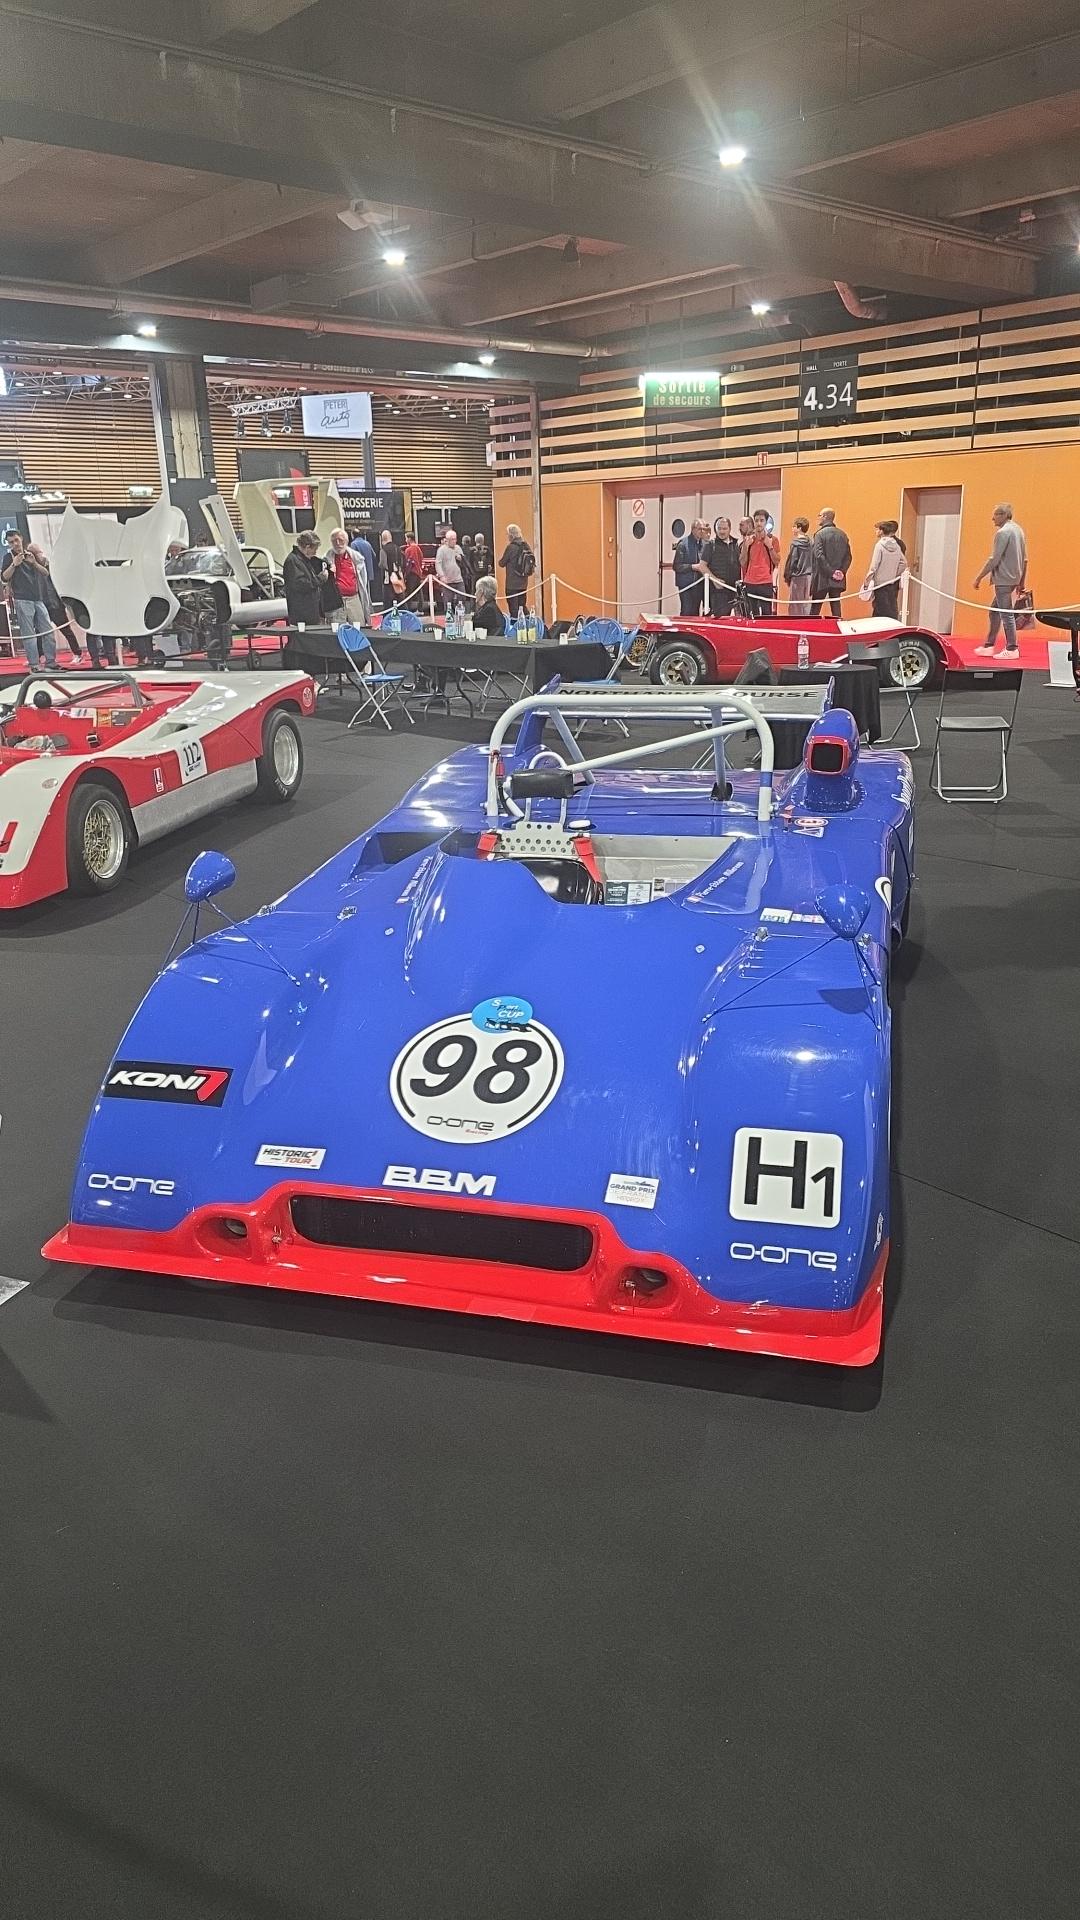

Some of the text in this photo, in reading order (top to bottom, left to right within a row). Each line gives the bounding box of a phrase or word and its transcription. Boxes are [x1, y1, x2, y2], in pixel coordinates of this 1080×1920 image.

[833, 360, 848, 368] PORTE
[658, 378, 706, 393] Sortie
[653, 394, 711, 406] de secours
[803, 381, 854, 411] 4.34
[325, 401, 346, 410] PETER
[716, 690, 819, 698] OURSE
[183, 742, 202, 766] 112
[498, 1010, 525, 1018] CUP
[409, 1034, 543, 1105] 98
[382, 1165, 497, 1197] BBM
[743, 1136, 836, 1218] H1
[609, 1183, 656, 1194] GRAND PRIX
